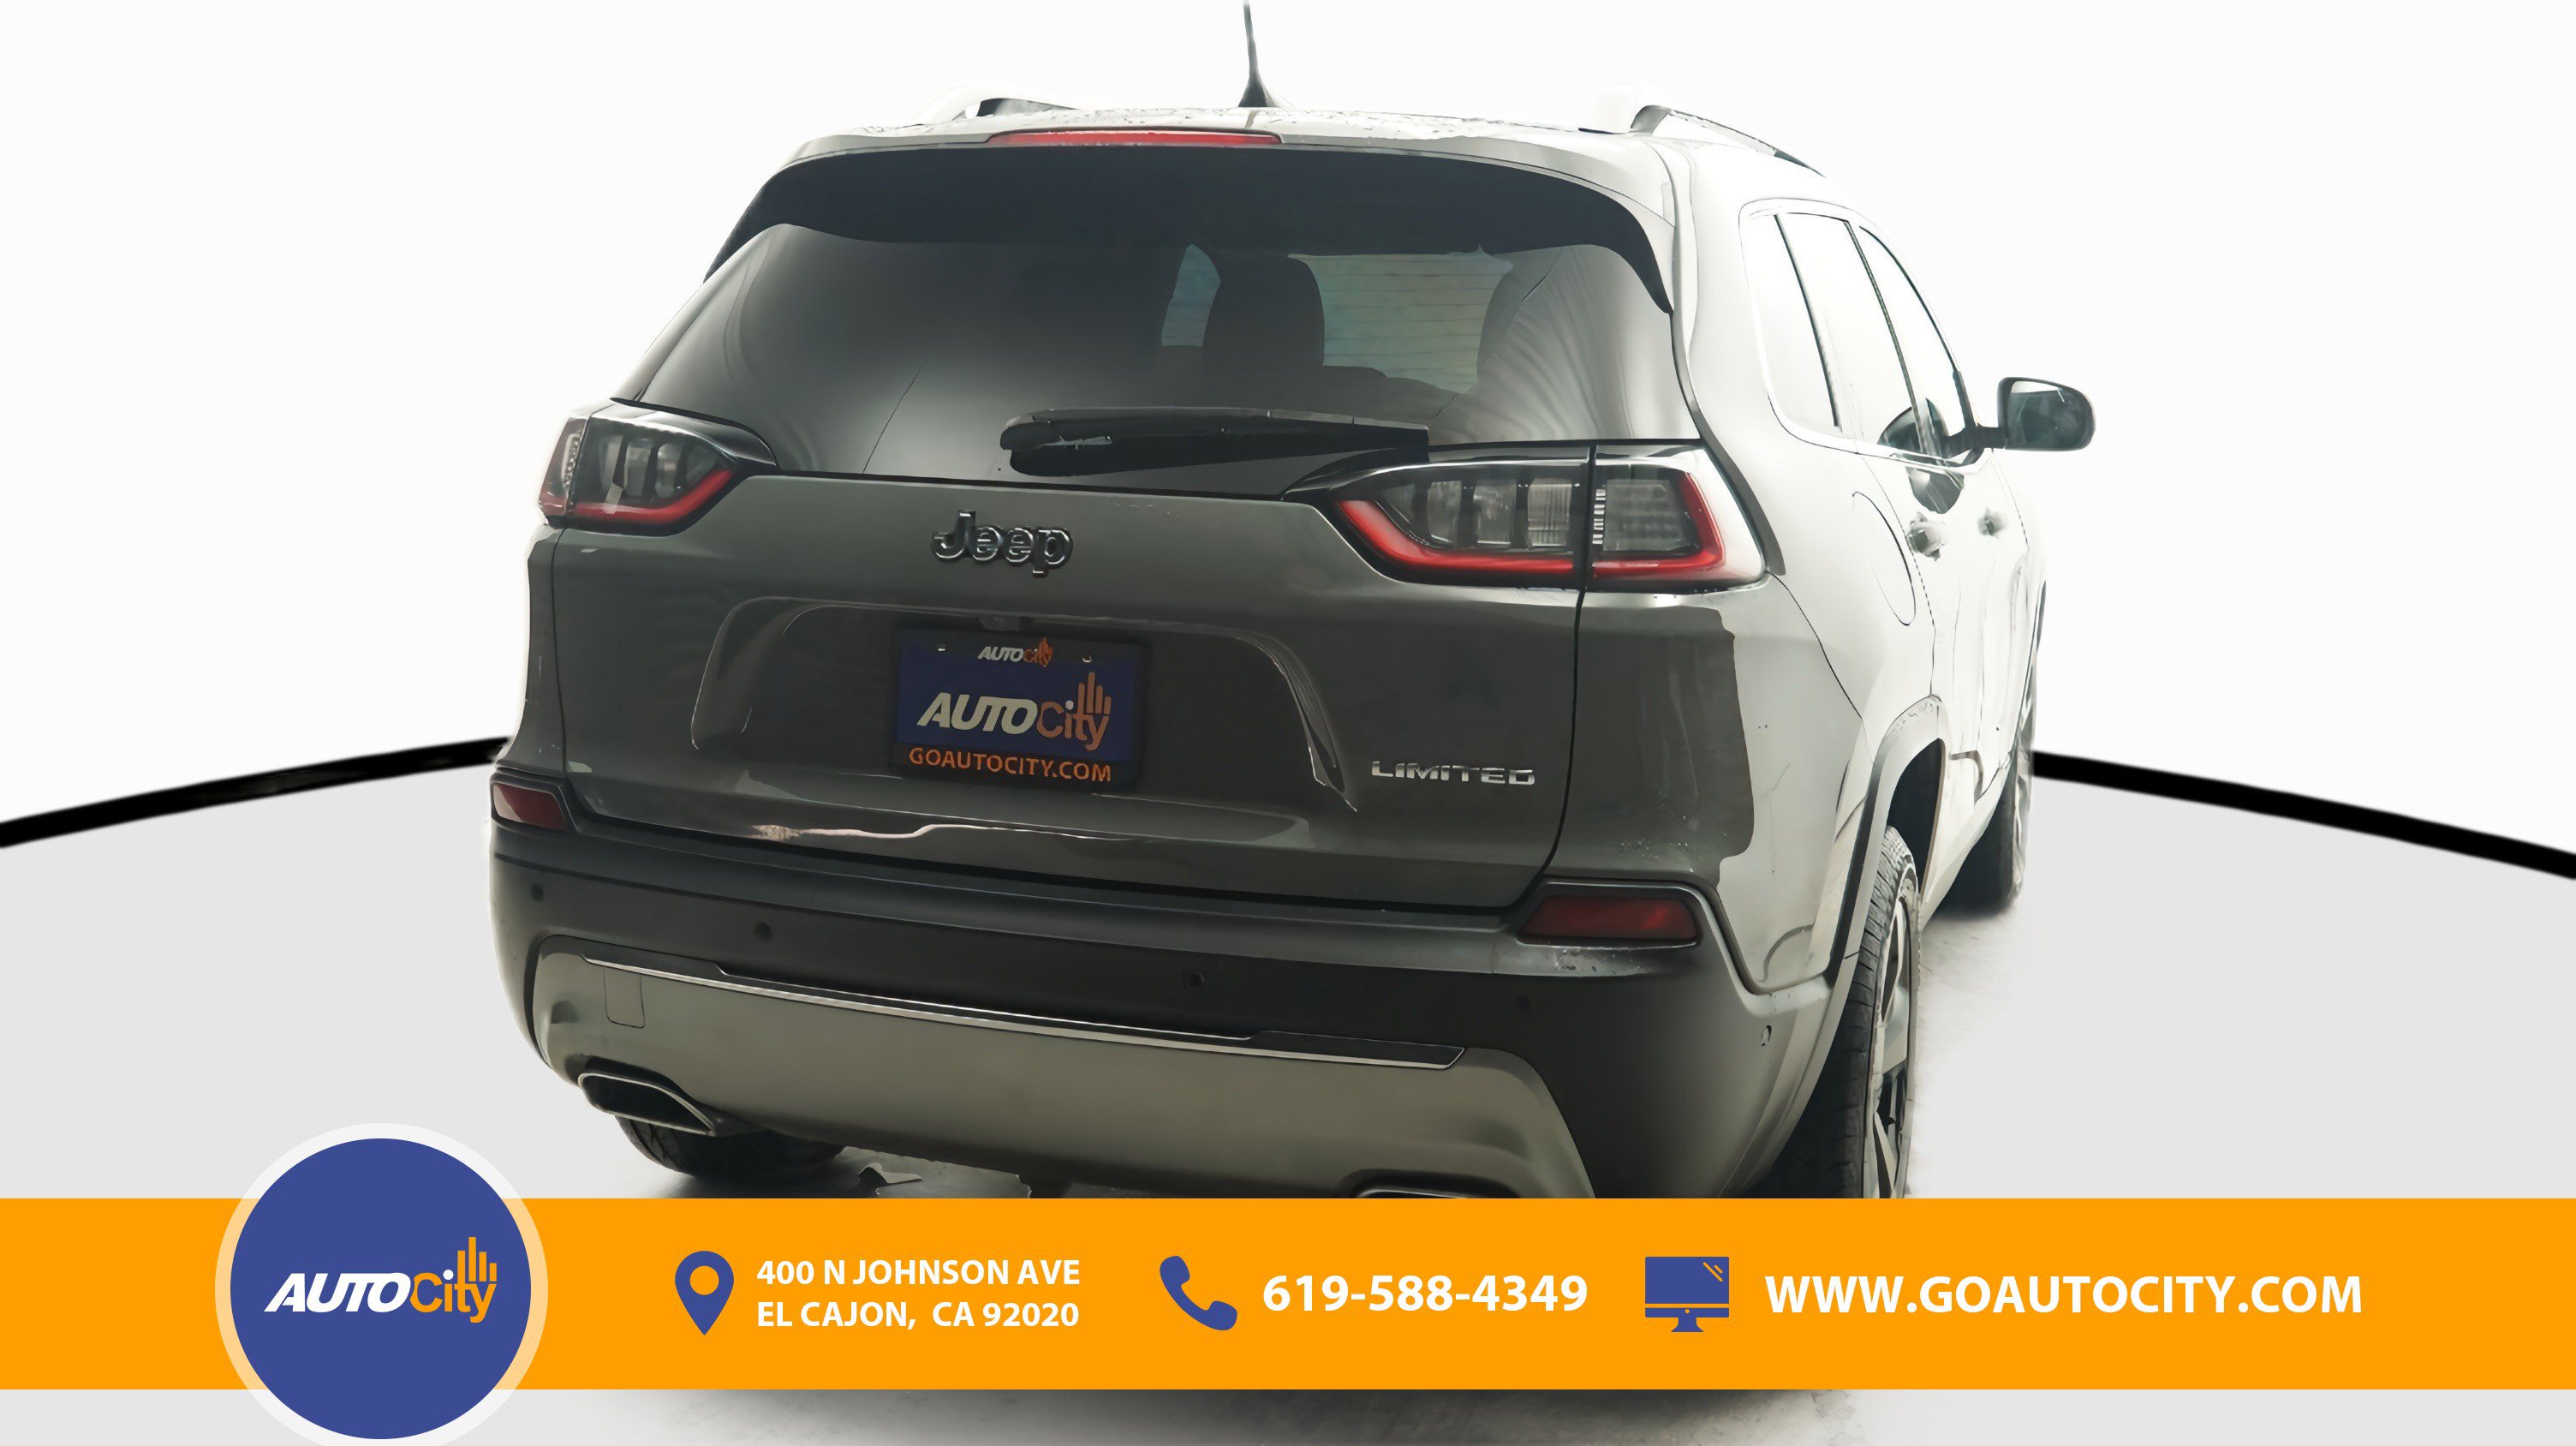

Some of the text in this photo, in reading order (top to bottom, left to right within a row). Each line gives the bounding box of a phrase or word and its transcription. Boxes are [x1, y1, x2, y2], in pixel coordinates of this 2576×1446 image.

[931, 510, 1073, 578] Jeep
[909, 746, 1112, 782] GOAUTOCITY.COM
[1371, 761, 1535, 785] LIMITED
